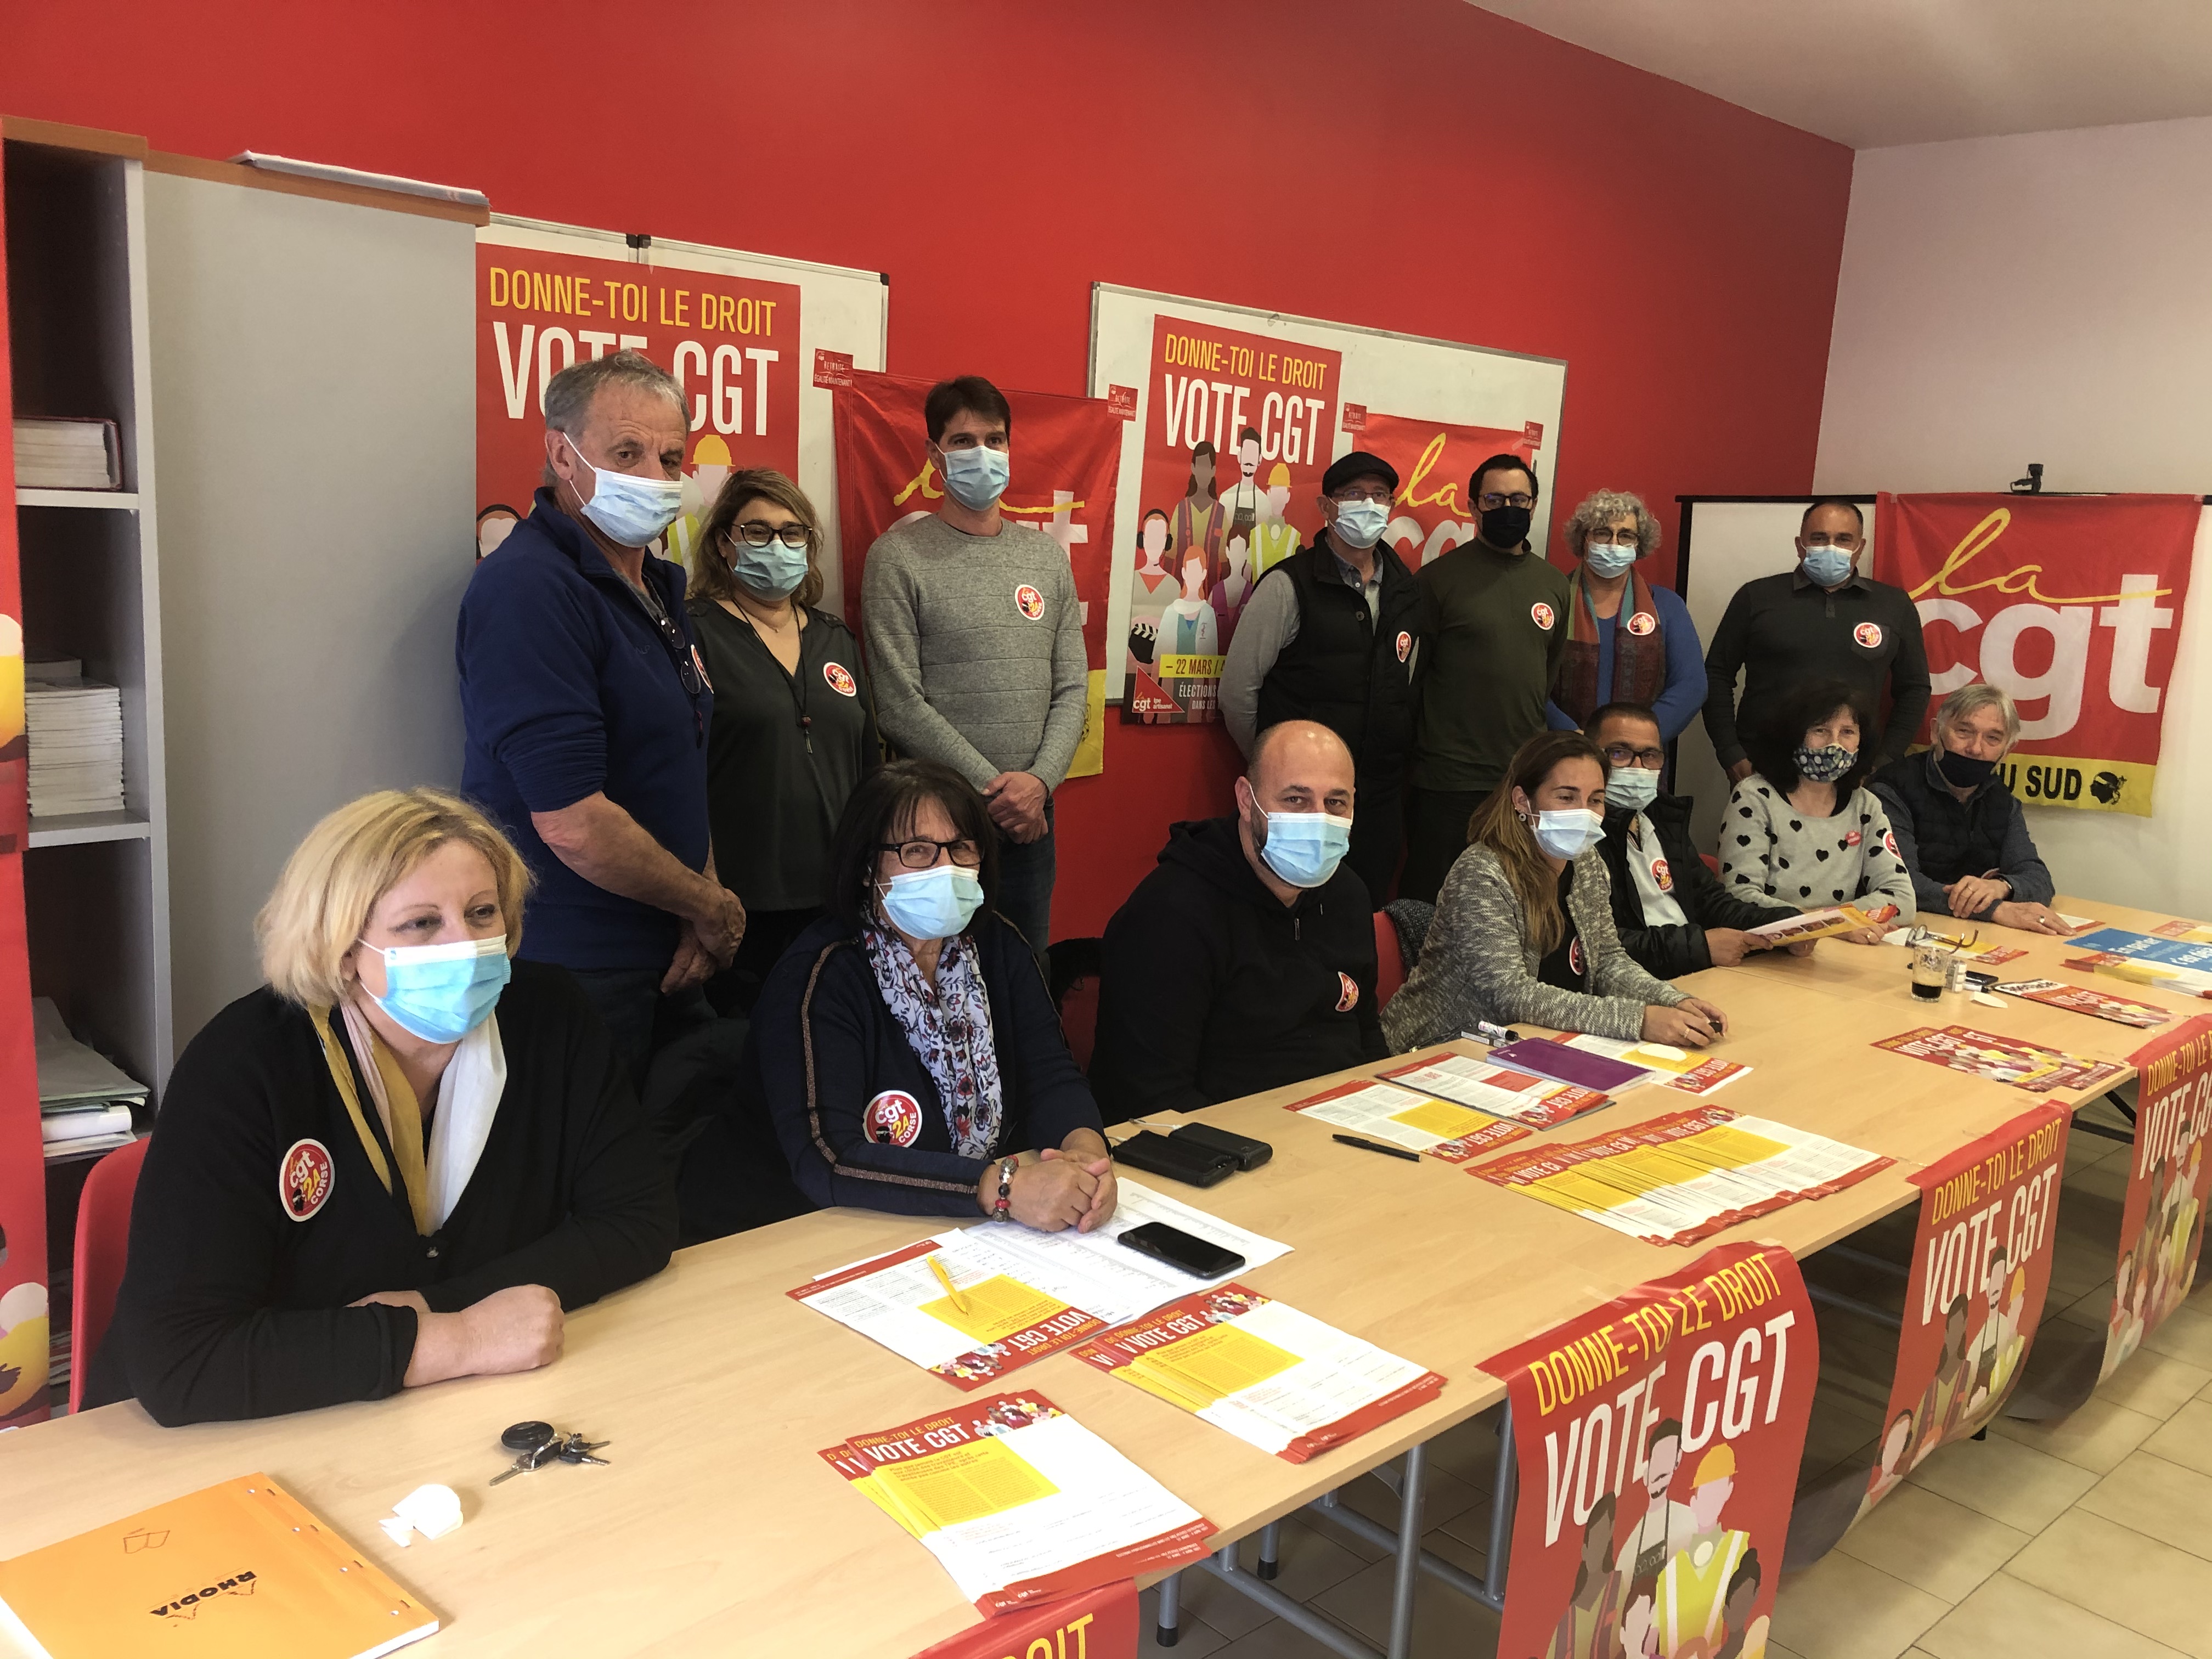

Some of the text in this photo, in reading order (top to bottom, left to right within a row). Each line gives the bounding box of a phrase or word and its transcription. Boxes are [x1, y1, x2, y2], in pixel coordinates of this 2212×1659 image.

[489, 267, 777, 336] DONNE-TOI LE DROIT
[1165, 334, 1327, 391] DONNE-TOI LE DROIT
[673, 340, 780, 437] CGT
[1165, 374, 1325, 466] VOTE CGT
[1908, 507, 2172, 603] la
[1021, 591, 1037, 603] cgt
[1176, 659, 1187, 675] 22
[1188, 659, 1212, 675] MARS
[1920, 574, 2174, 741] cgt
[1133, 698, 1150, 712] cgt
[1179, 681, 1217, 697] ÉLECTIONS
[1192, 700, 1216, 709] DANS LES
[2025, 765, 2083, 800] SUD
[1894, 1041, 1943, 1056] VOTE
[2147, 1040, 2195, 1096] DONNE-TOI
[2194, 1034, 2206, 1067] LE
[875, 1099, 906, 1124] cgt
[1547, 1096, 1570, 1108] CGT
[892, 1115, 909, 1139] 2A
[898, 1112, 917, 1143] CORSE
[1464, 1122, 1517, 1146] VOTE CGT
[1683, 1120, 1710, 1132] CGT
[2140, 1081, 2193, 1180] VOTE
[289, 1150, 315, 1188] cgt
[303, 1168, 321, 1201] 2A
[311, 1161, 328, 1205] CORSE
[1513, 1165, 1551, 1179] VOTE
[1932, 1117, 2062, 1225] DONNE-TOI LE DROIT
[1922, 1163, 2057, 1326] VOTE CGT
[1007, 1311, 1092, 1351] VOTE CGT
[1026, 1318, 1102, 1356] DONNE-TOI LE DROIT
[1114, 1310, 1185, 1338] DONNE-TOI LE DROIT
[1124, 1327, 1177, 1348] VOTE
[1166, 1314, 1206, 1334] CGT
[1528, 1252, 1781, 1417] DONNE-TOI LE DROIT
[854, 1416, 955, 1448] DONNE-TOI LE DROIT
[862, 1423, 970, 1463] VOTE CGT
[1545, 1310, 1796, 1548] VOTE CGT
[149, 1570, 258, 1618] RHODIA
